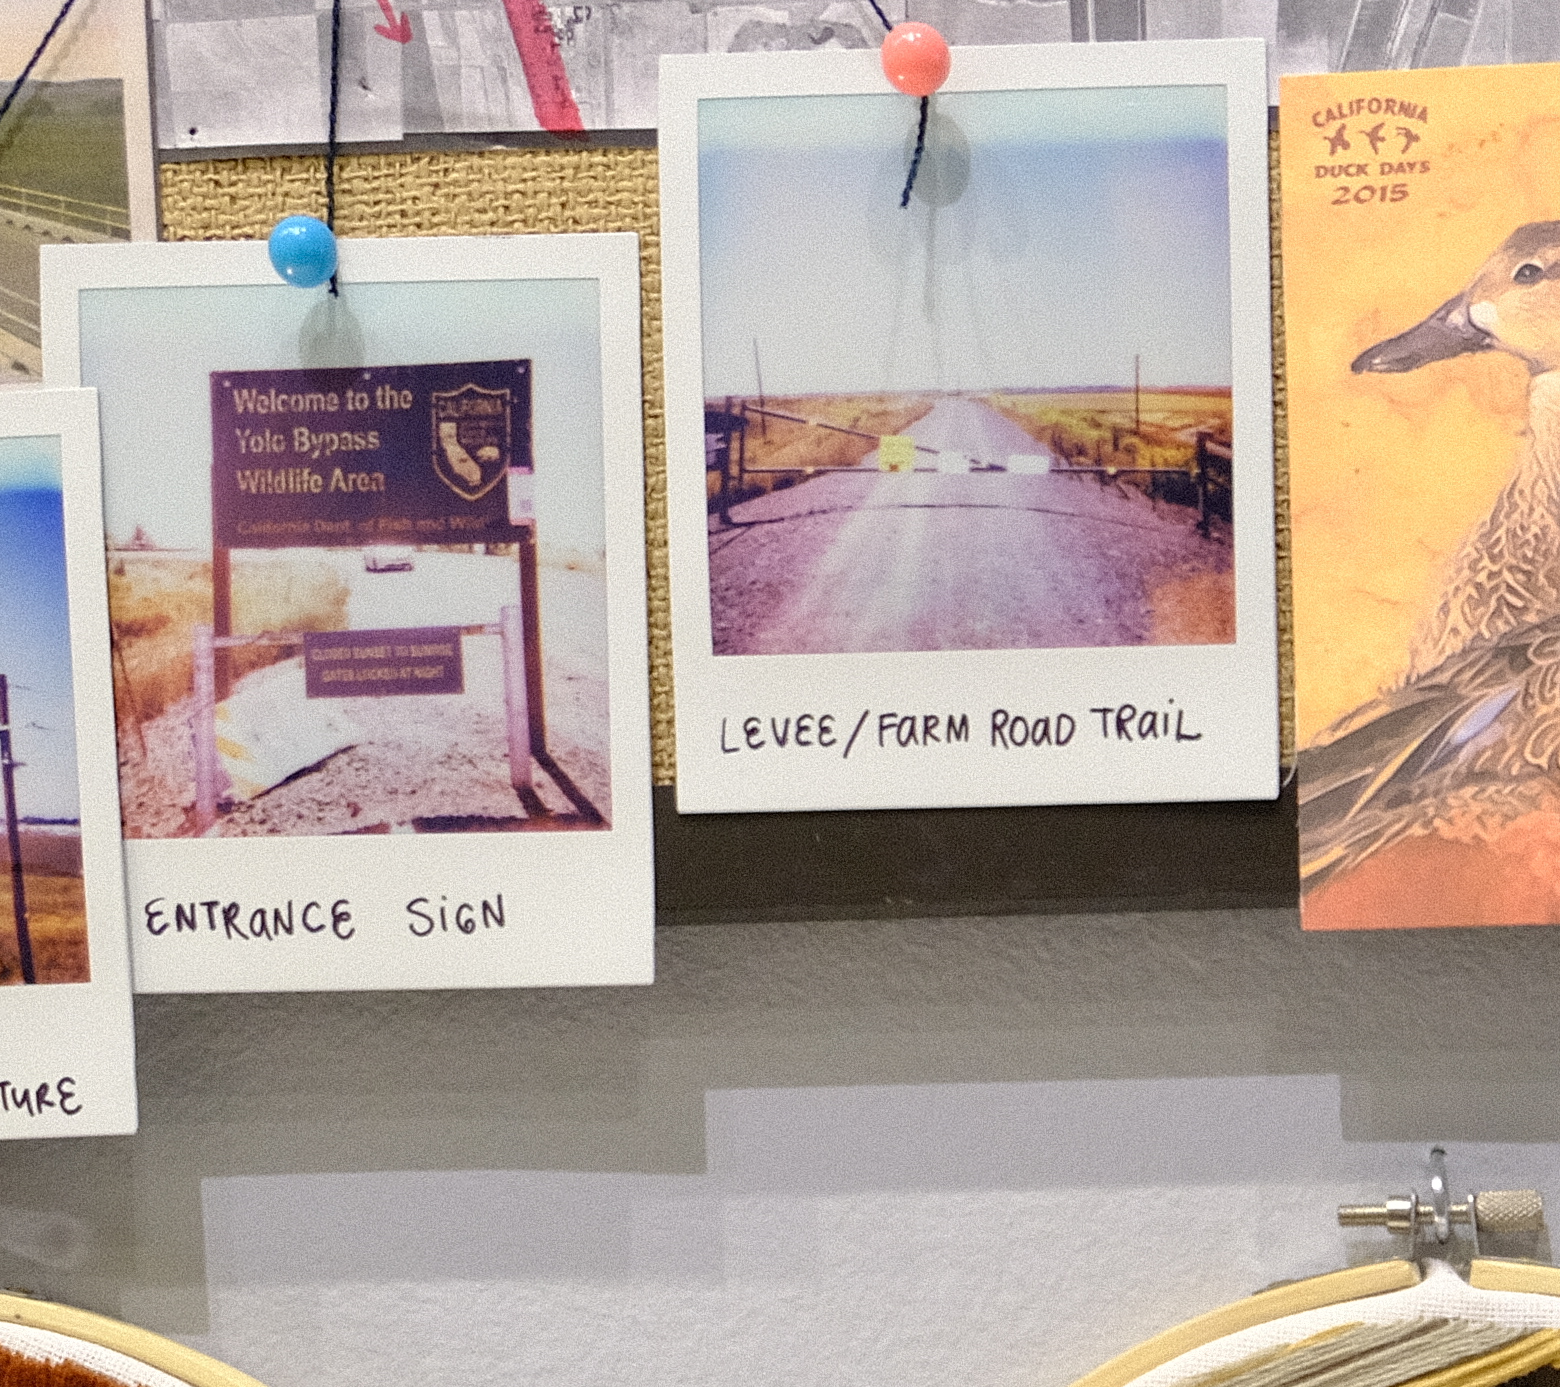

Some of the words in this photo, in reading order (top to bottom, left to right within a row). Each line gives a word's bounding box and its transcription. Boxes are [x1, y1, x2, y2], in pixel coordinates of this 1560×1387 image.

[1312, 97, 1428, 128] CALIFORNIA
[1314, 163, 1369, 178] DUCK
[1379, 160, 1430, 175] DAYS
[1331, 184, 1410, 205] 2015
[233, 389, 339, 414] Welcome
[346, 390, 369, 411] to
[376, 386, 413, 410] the
[235, 428, 286, 454] Yolo
[293, 427, 380, 458] Bypass
[239, 469, 323, 494] Wildlife
[330, 467, 384, 492] Area
[990, 708, 1076, 748] ROAD
